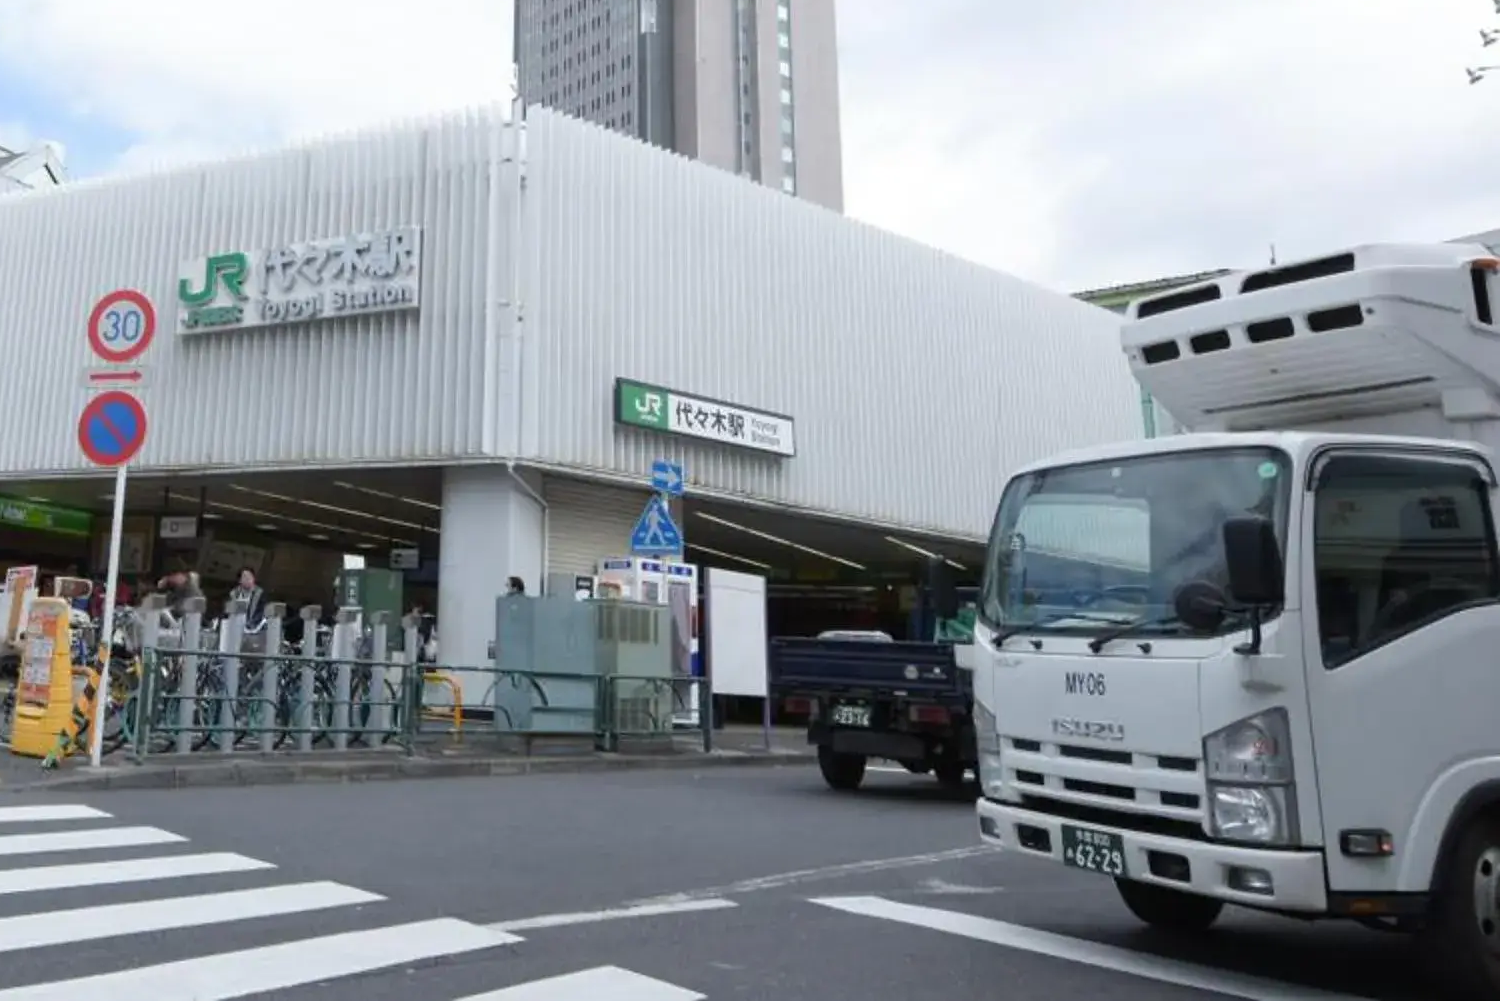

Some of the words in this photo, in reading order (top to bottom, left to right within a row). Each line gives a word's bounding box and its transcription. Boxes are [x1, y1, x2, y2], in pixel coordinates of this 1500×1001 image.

[179, 251, 247, 303] JR
[261, 231, 415, 296] 代々木駅
[260, 298, 324, 321] Yoyogi
[333, 283, 414, 312] Station
[103, 310, 140, 342] 30
[635, 393, 663, 416] JR
[675, 400, 746, 440] 代々木駅
[1051, 718, 1125, 742] ISUZU
